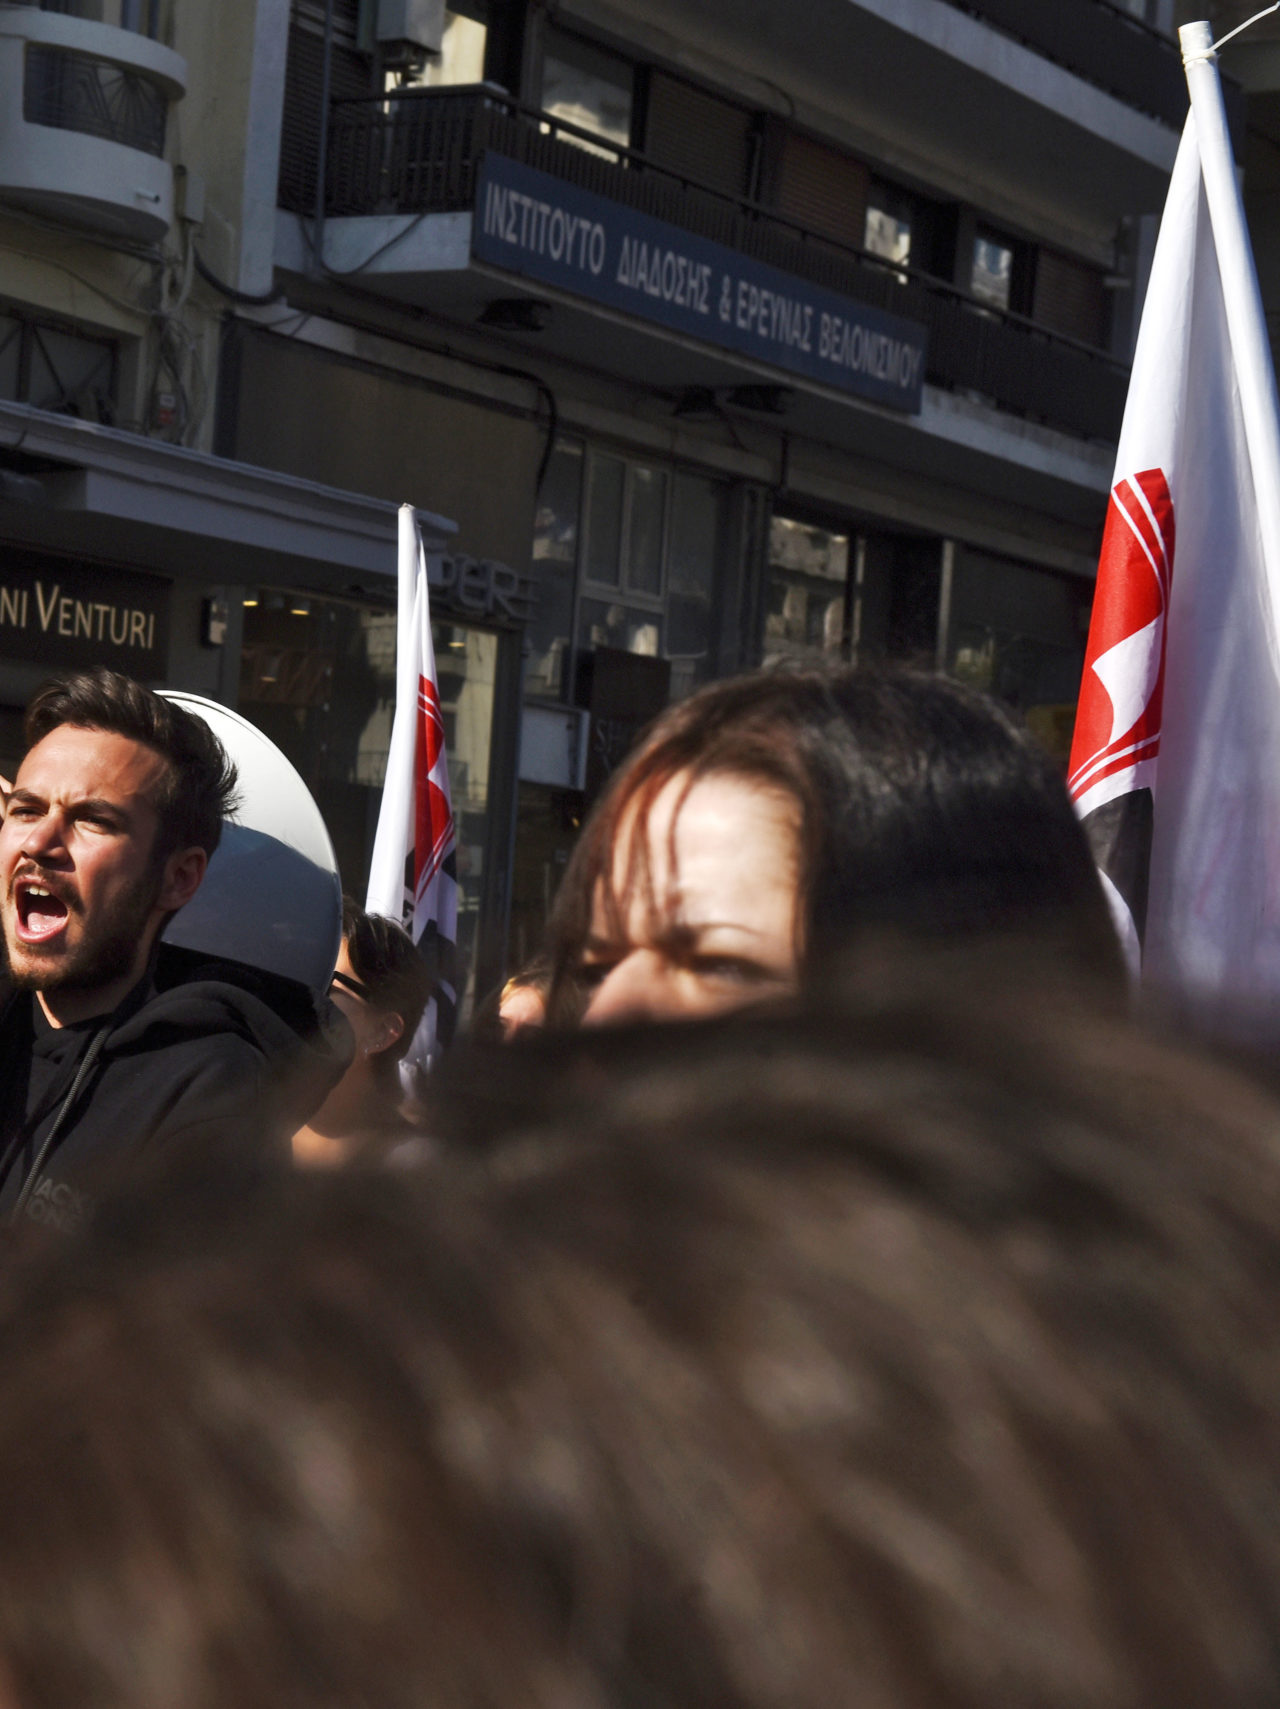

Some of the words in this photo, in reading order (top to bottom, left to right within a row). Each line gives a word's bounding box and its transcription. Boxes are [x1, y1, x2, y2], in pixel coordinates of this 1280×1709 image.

[483, 181, 606, 276] ΙΝΣΤΙΤΟΥΤΟ
[616, 234, 713, 315] ΔΙΑΔΟΣΗΣ
[719, 274, 732, 323] &
[736, 279, 815, 353] ΕΡΕΥΝΑΣ
[818, 311, 923, 390] ΒΕΛΟΝΙΣΜΟΥ
